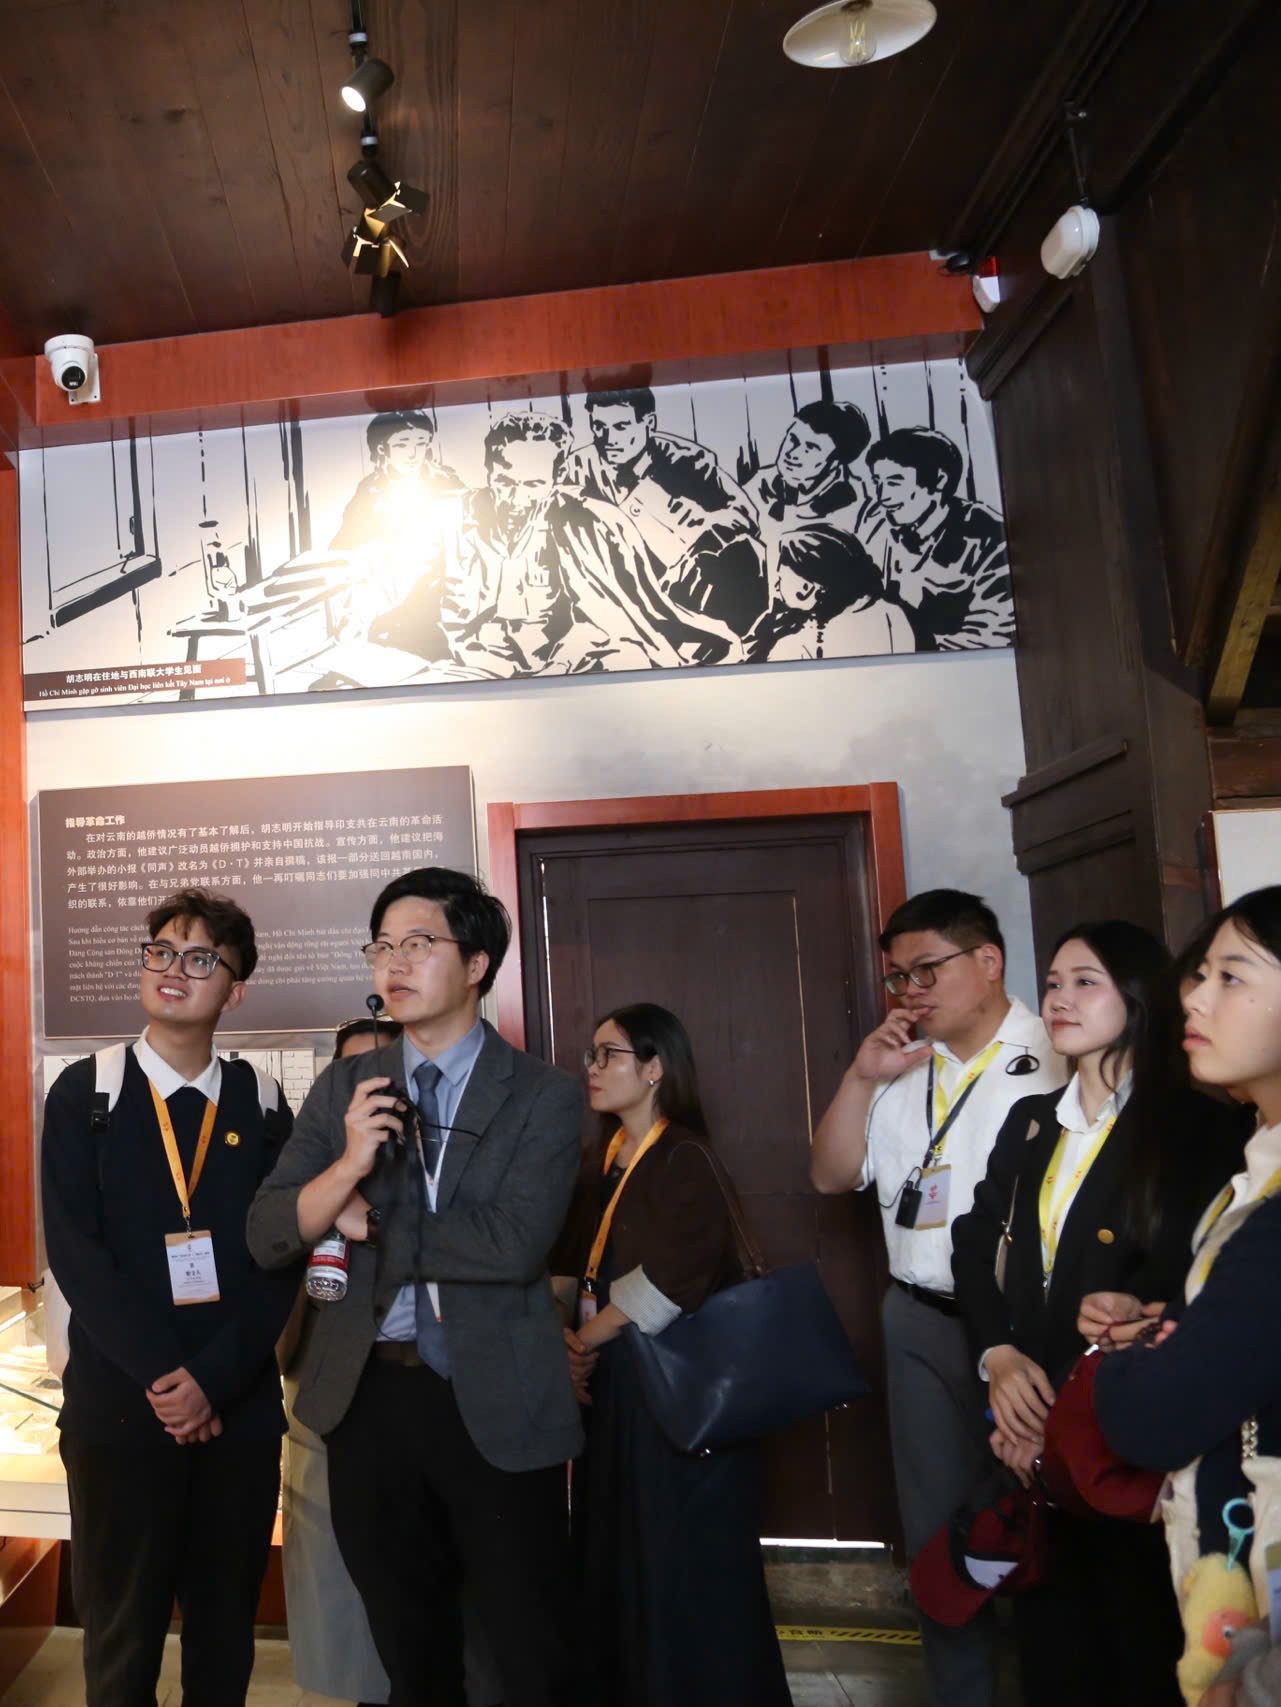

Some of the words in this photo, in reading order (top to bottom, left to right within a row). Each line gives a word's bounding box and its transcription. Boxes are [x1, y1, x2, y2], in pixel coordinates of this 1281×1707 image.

[66, 665, 201, 683] 胡志明在住地与西南联大学生见面
